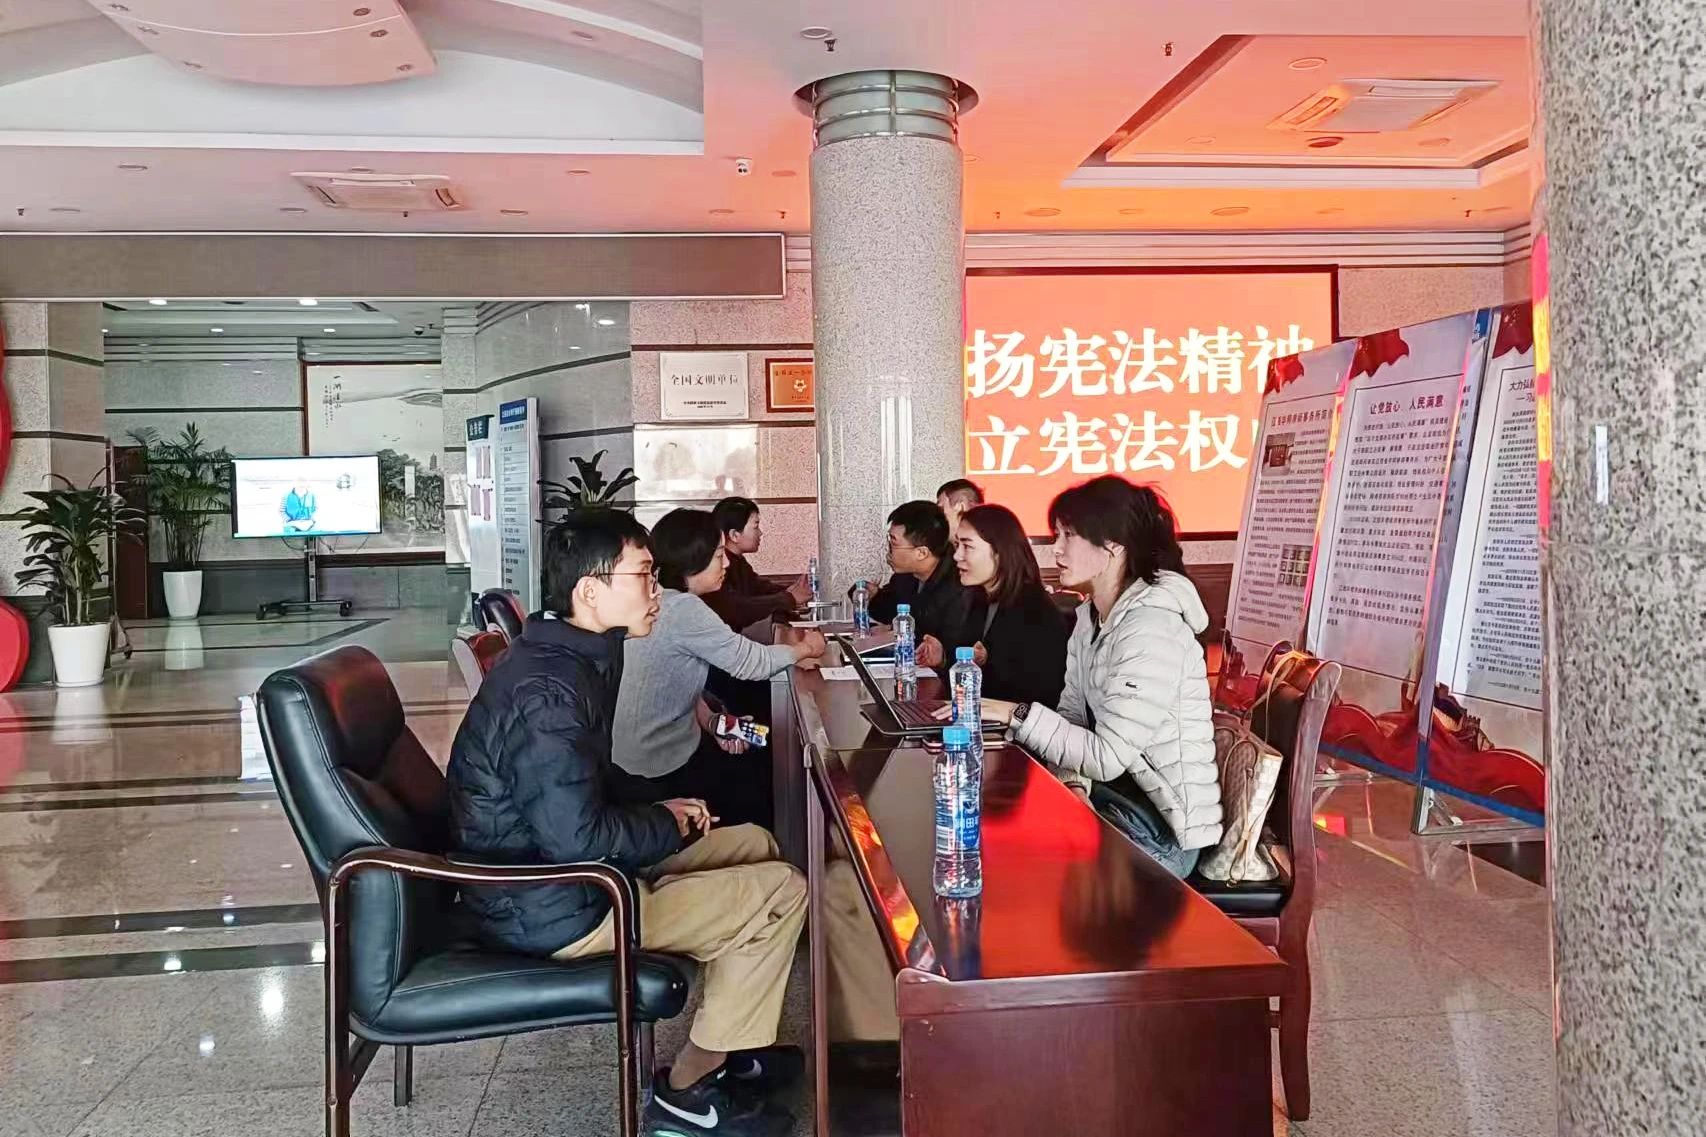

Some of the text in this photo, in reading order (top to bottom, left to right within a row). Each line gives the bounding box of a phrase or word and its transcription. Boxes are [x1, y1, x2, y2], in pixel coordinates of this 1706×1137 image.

[671, 374, 738, 386] 全国文明单位
[967, 324, 1314, 398] 扬宪法精神
[1370, 394, 1444, 415] 让党放心 人民满意
[967, 410, 1259, 476] 立宪法权
